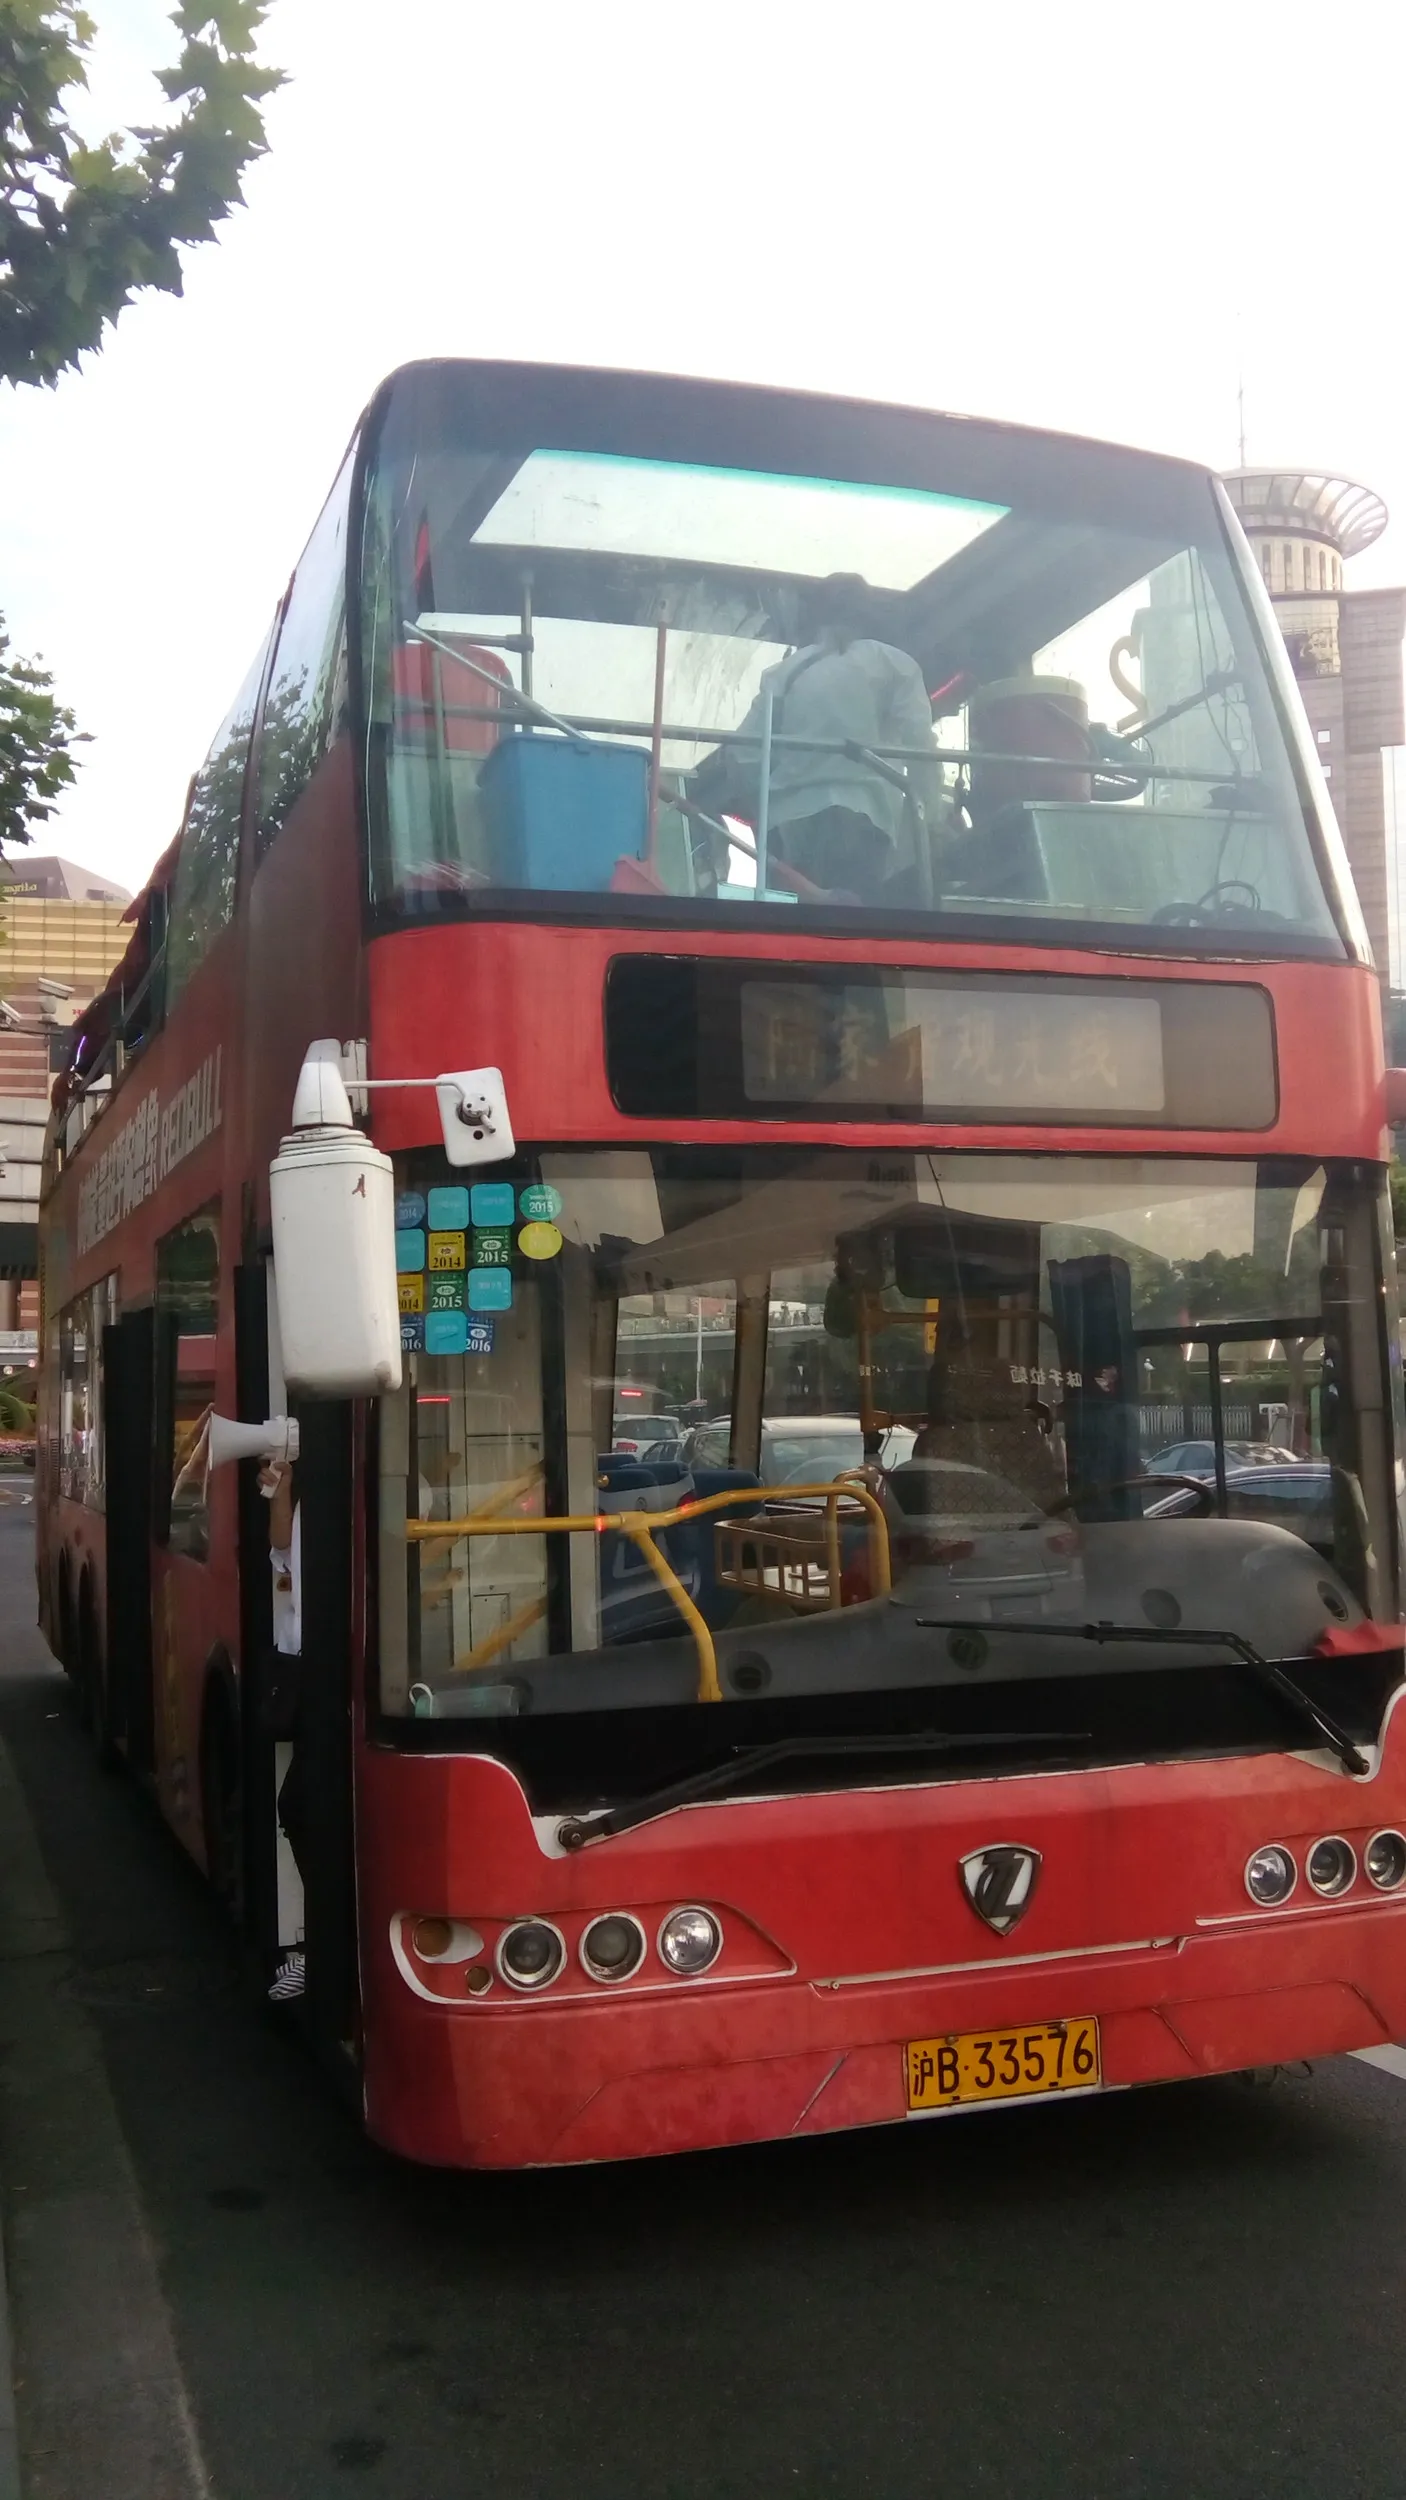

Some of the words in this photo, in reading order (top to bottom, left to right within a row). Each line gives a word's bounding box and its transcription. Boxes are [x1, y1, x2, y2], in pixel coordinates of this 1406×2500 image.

[529, 1201, 554, 1213] 2015
[433, 1257, 461, 1268] 2014
[477, 1251, 509, 1263] 2015
[399, 1299, 419, 1310] 014
[432, 1296, 462, 1308] 2015
[401, 1338, 422, 1351] 016
[465, 1338, 491, 1352] 2016
